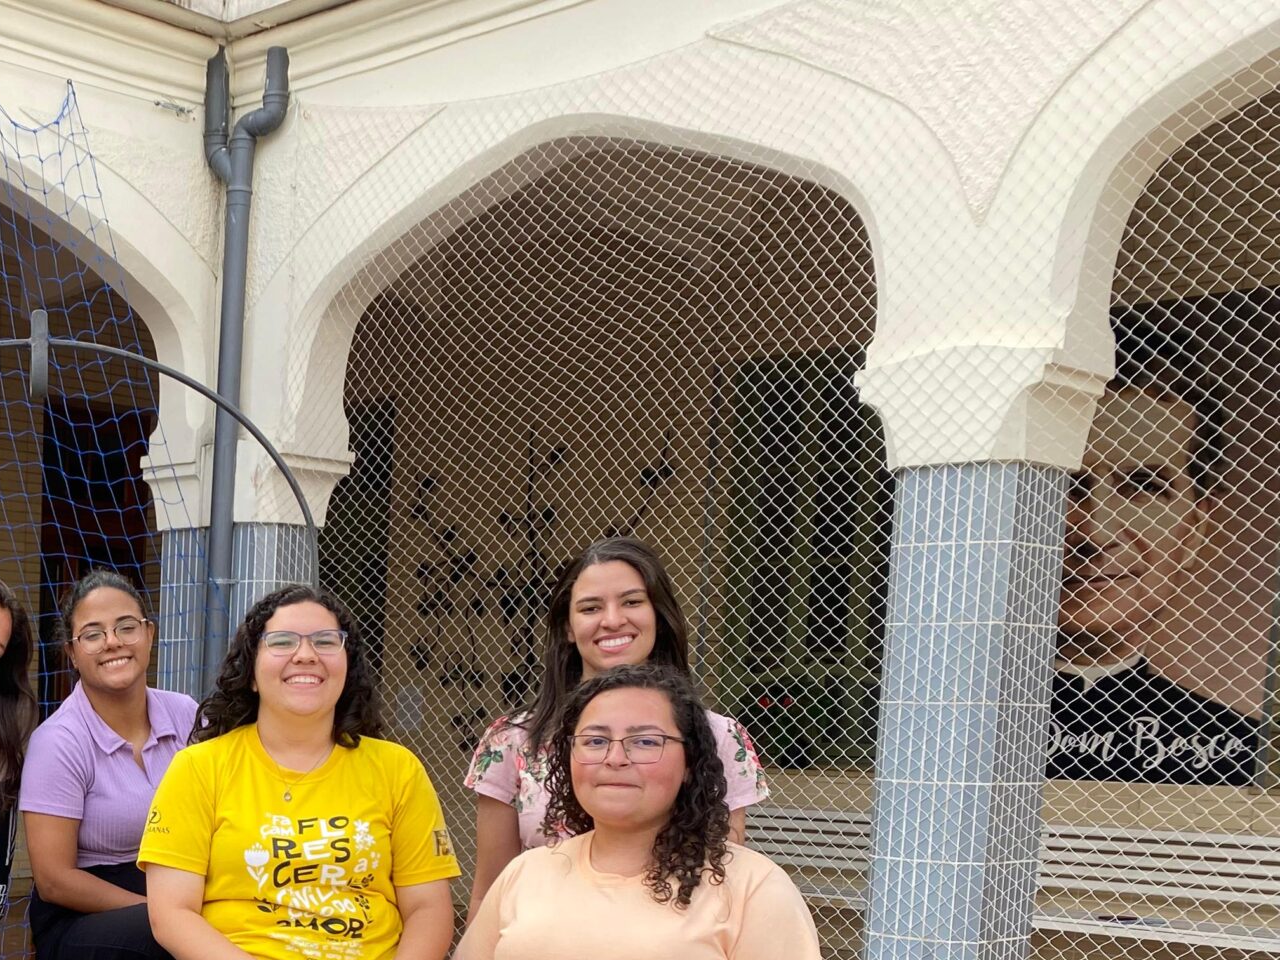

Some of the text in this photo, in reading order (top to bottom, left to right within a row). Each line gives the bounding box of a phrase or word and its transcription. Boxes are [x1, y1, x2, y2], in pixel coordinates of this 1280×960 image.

[1128, 716, 1251, 769] Bosco
[297, 816, 350, 838] FLO
[272, 837, 351, 863] RES
[272, 860, 348, 889] CER
